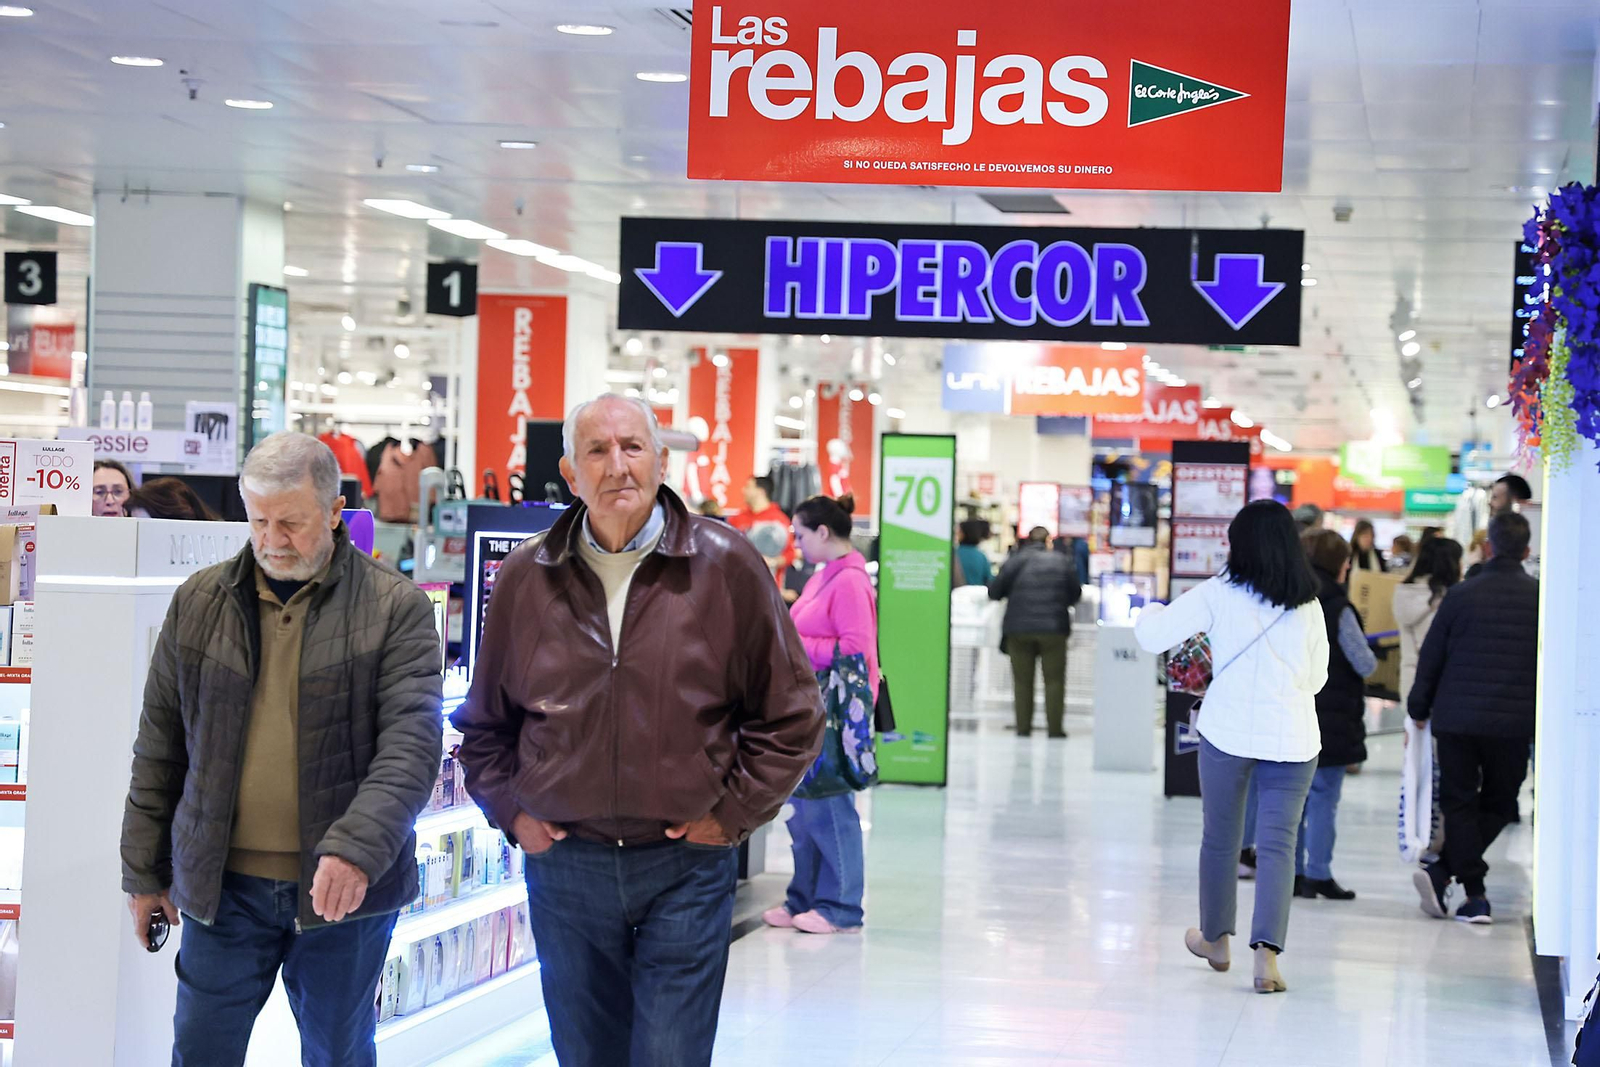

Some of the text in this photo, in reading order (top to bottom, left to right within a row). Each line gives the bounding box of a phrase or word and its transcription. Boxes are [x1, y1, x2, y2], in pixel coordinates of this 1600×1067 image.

[711, 6, 789, 46] Las
[709, 27, 1109, 146] rebajas
[1134, 83, 1220, 104] El Corte Inglés
[843, 160, 1113, 175] SI NO QUEDA SATISFECHO LE DEVOLVEMOS SU DINERO
[18, 259, 42, 297] 3
[442, 271, 462, 307] 1
[764, 236, 1150, 327] HIPERCOR
[507, 307, 534, 479] REBAJA
[86, 433, 148, 453] essie
[33, 454, 74, 468] TODO
[26, 469, 80, 490] -10%
[488, 540, 509, 553] THE
